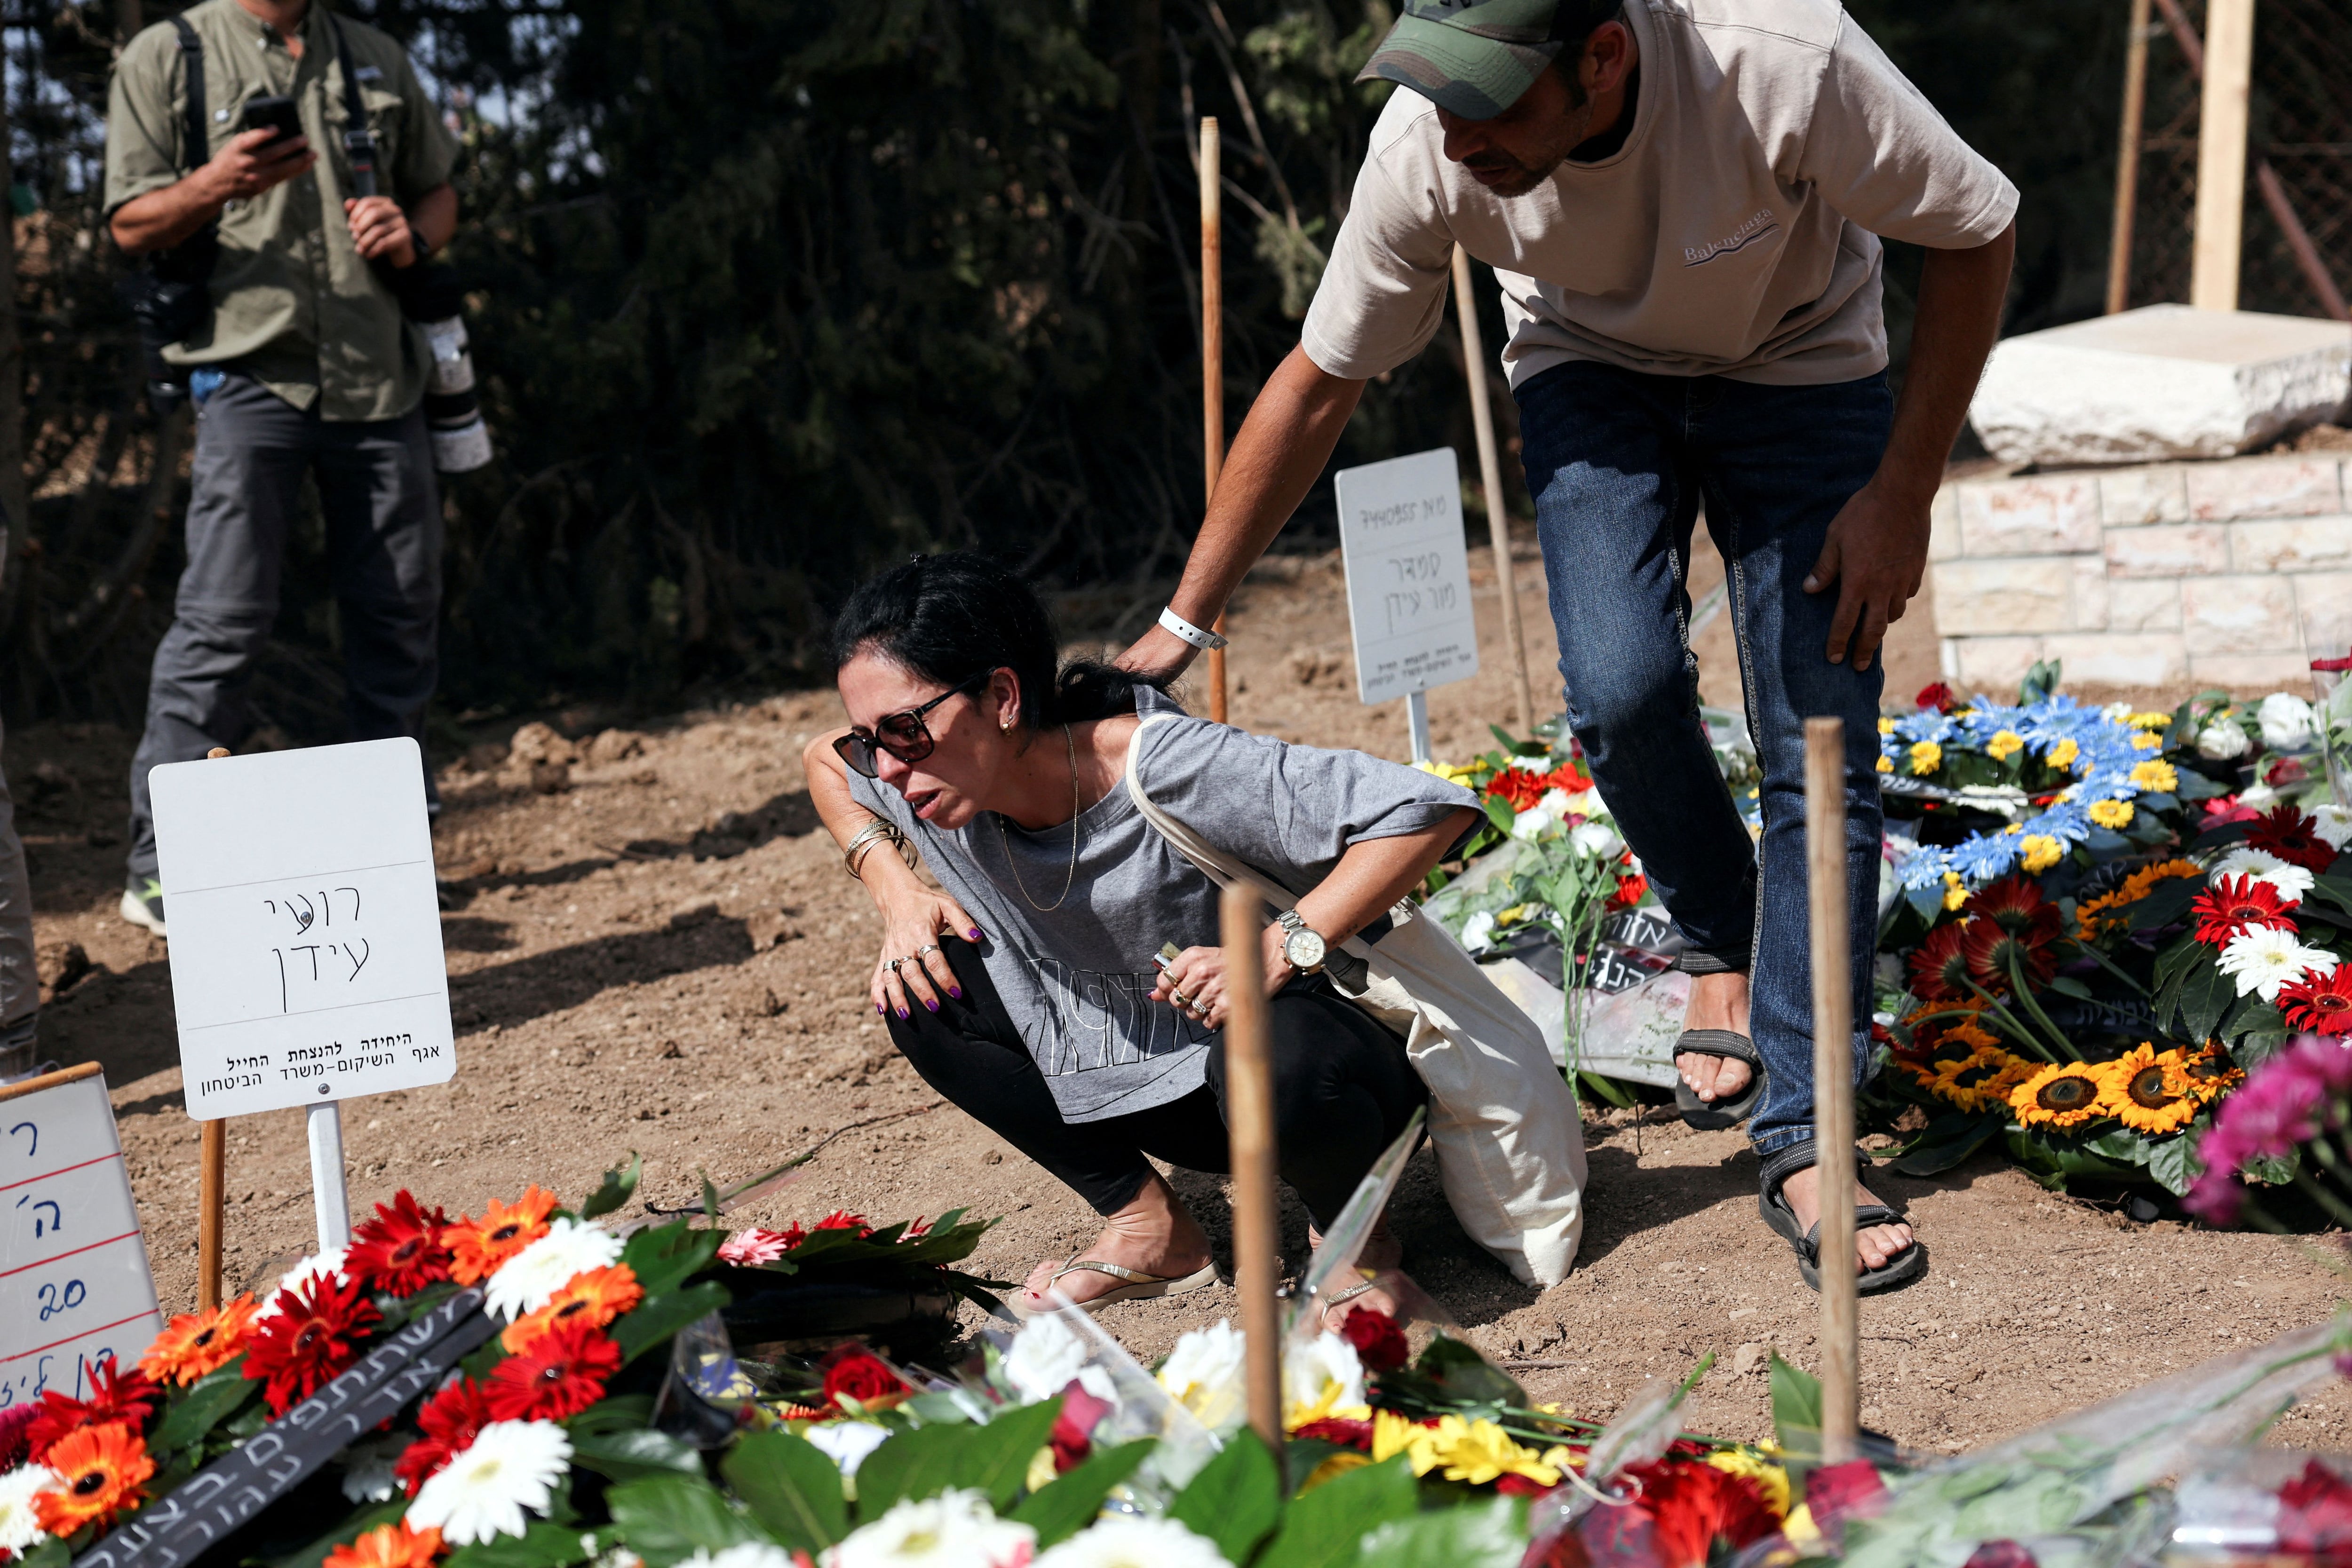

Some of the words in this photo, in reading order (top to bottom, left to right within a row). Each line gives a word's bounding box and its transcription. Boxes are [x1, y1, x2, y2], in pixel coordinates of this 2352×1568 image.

[1683, 208, 1773, 261] Balenciaga
[1388, 552, 1441, 582] סמדר
[1384, 590, 1422, 635] עידן
[272, 938, 369, 1014] עידן
[288, 1040, 342, 1062] להנצחת
[360, 1033, 412, 1051] היחידה
[412, 1045, 440, 1063] אגף
[226, 1054, 269, 1071] החייל
[201, 1072, 262, 1096] הביטחון
[39, 1279, 86, 1322] 20
[244, 1286, 485, 1469] משתתפים
[320, 1357, 442, 1436] אדר
